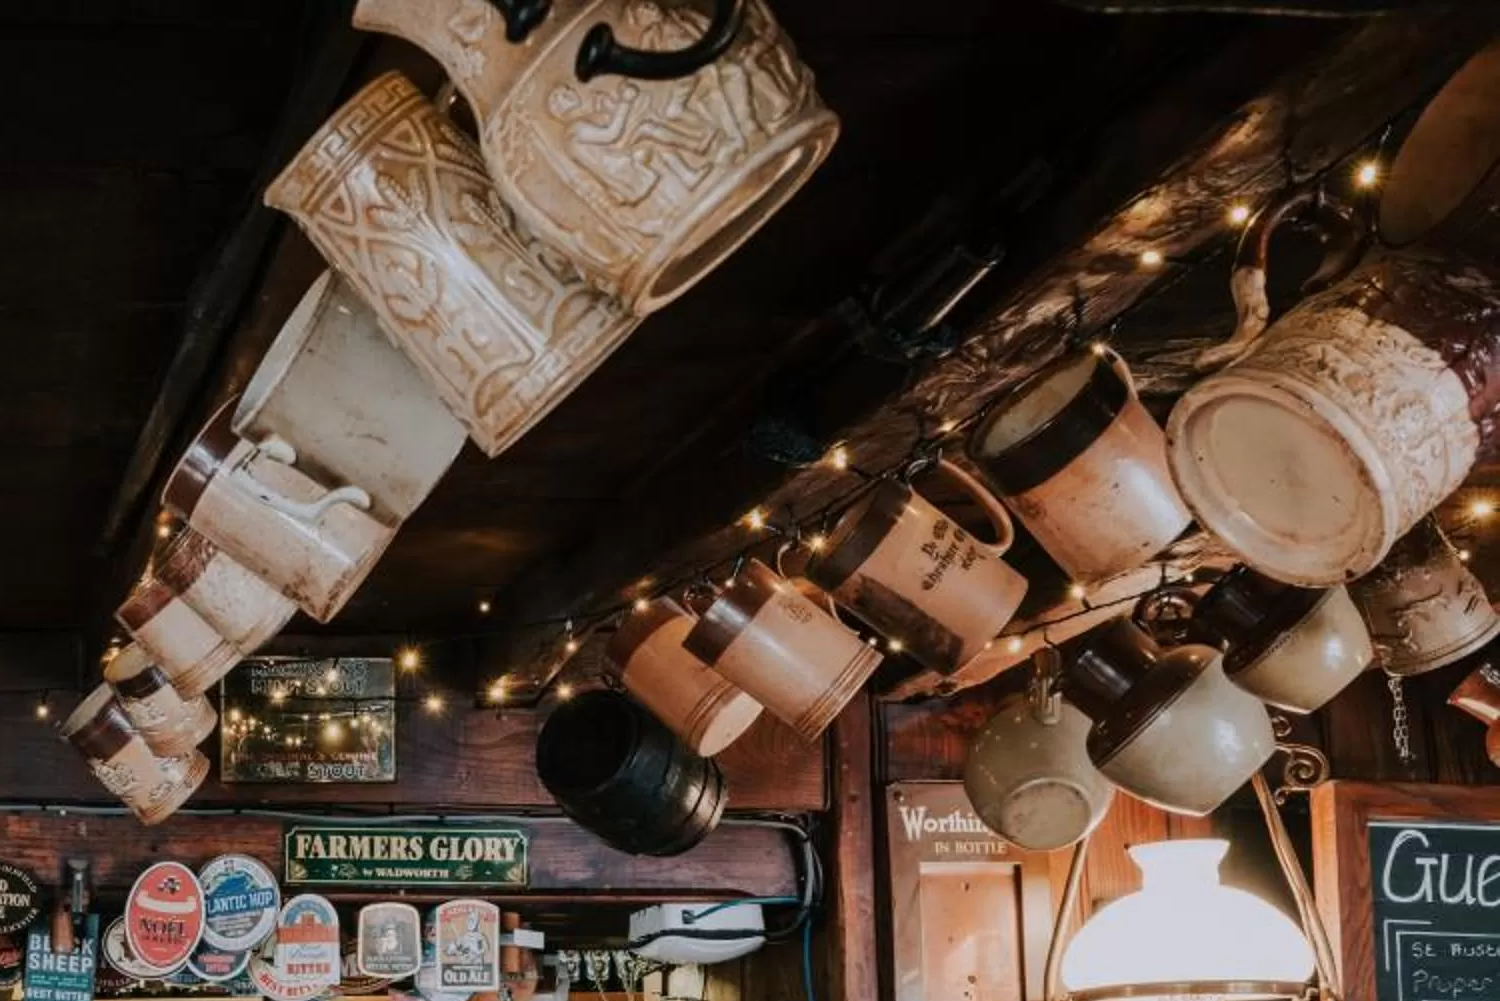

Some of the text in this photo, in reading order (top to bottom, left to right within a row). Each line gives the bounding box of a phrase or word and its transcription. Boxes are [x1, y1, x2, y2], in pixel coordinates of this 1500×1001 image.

[306, 763, 366, 780] STOUT
[899, 806, 989, 841] Worthin
[295, 834, 519, 862] FARMERS GLORY
[955, 841, 1007, 855] BOTTLE
[375, 867, 450, 879] WADWORTH
[206, 890, 274, 914] LANTIC HOP
[28, 933, 95, 956] BLCK
[1411, 941, 1437, 958] St
[27, 951, 94, 974] SHEEP
[442, 969, 491, 984] OLD ALE
[1411, 968, 1493, 999] Proper
[28, 987, 53, 1001] BEST
